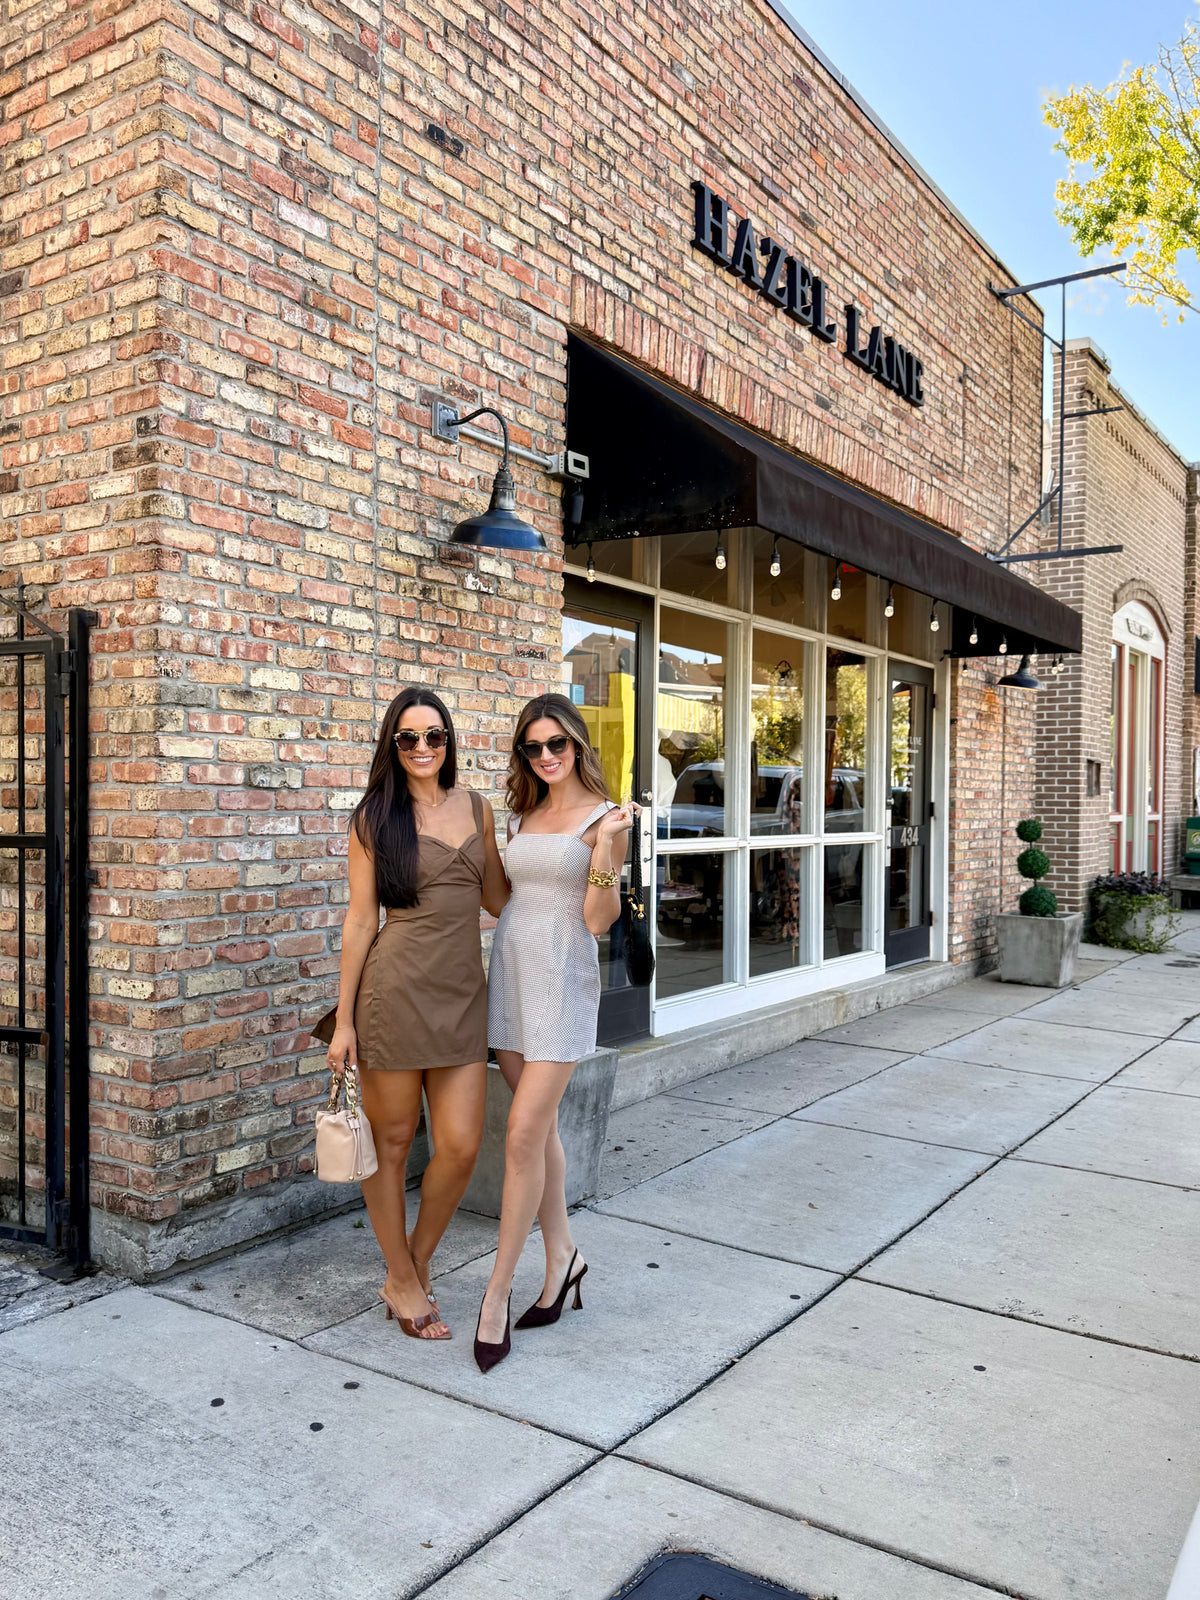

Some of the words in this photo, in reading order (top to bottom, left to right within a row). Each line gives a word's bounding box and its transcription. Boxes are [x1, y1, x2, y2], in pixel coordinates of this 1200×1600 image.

[691, 181, 837, 343] HAZEL
[844, 304, 924, 407] LANE
[900, 826, 919, 846] 434
